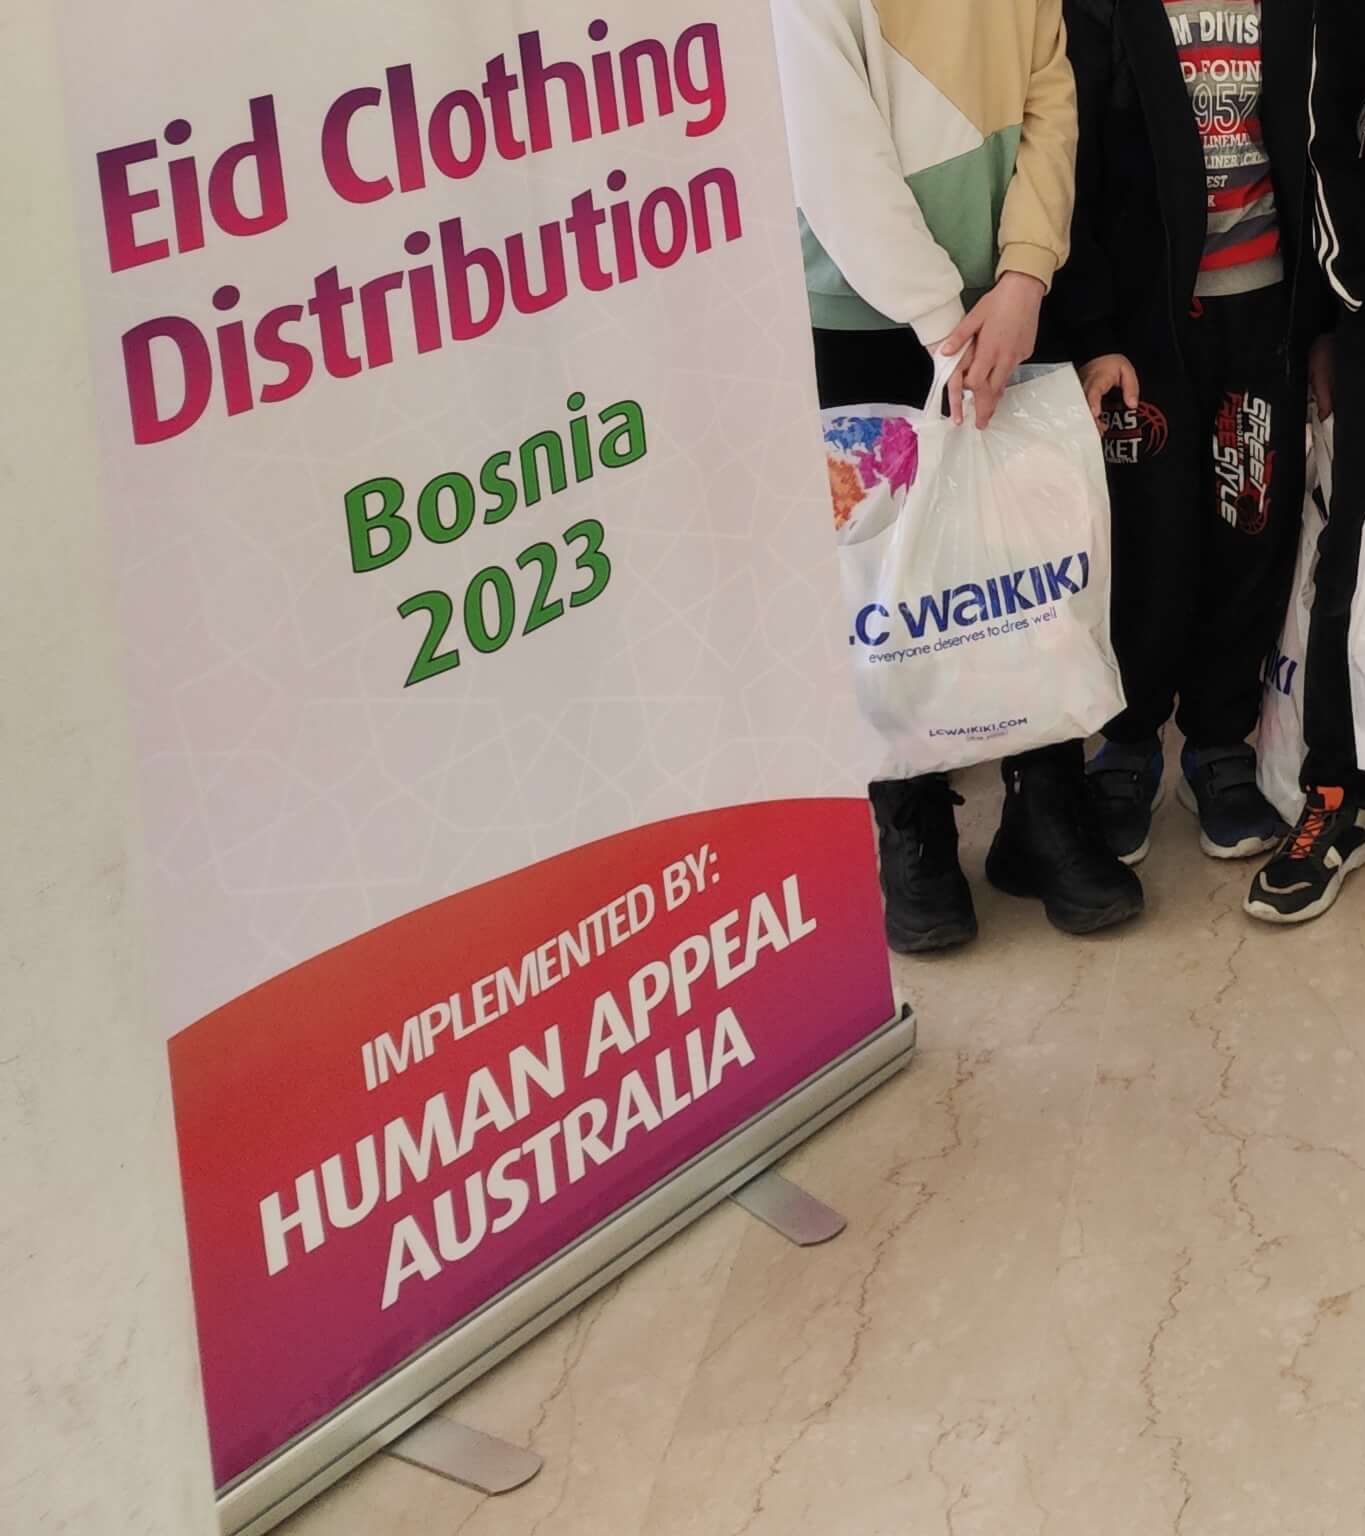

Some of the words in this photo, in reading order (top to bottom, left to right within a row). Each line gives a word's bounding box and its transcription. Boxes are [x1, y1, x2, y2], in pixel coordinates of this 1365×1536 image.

[1200, 11, 1259, 44] DIVIS
[96, 93, 289, 274] Eid
[320, 18, 728, 205] Clothing
[121, 167, 743, 445] Distribution
[344, 392, 647, 573] Bosnia
[1242, 392, 1271, 513] STREET
[397, 518, 612, 688] 2023
[849, 602, 890, 646] C
[869, 642, 931, 664] everyone
[933, 630, 985, 652] deserves
[987, 626, 999, 638] to
[1001, 617, 1030, 636] dres
[1032, 606, 1058, 625] well
[929, 716, 1028, 738] LCWAIKIKI.COM
[361, 883, 656, 1092] IMPLEMENTED
[662, 844, 721, 912] BY:
[259, 1024, 566, 1277] HUMAN
[584, 874, 817, 1079] APPEAL
[380, 1007, 756, 1311] AUSTRALIA
